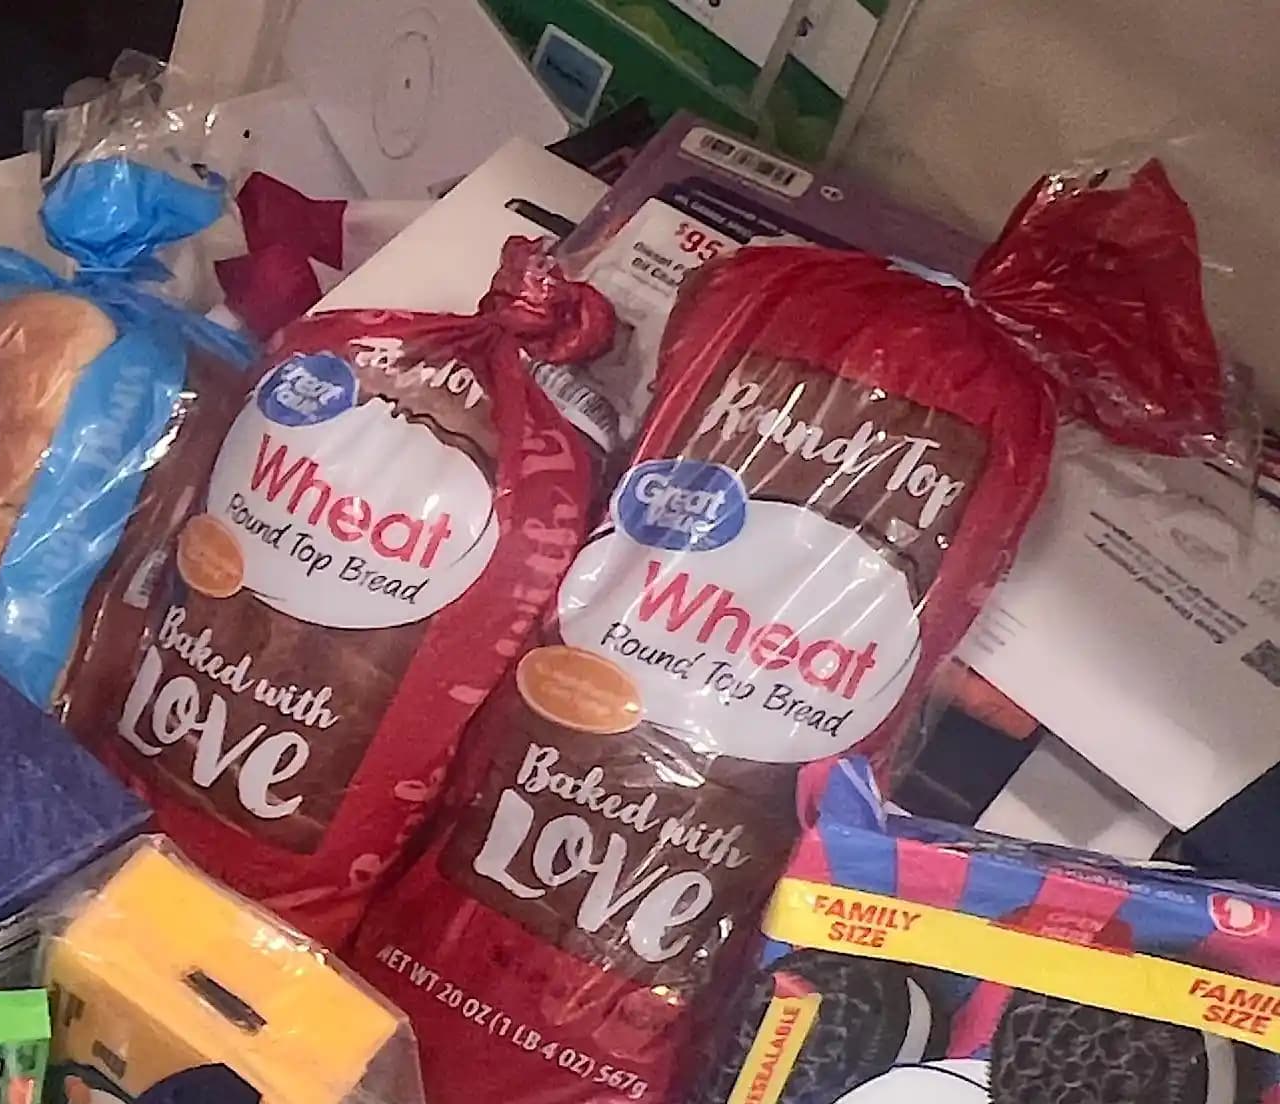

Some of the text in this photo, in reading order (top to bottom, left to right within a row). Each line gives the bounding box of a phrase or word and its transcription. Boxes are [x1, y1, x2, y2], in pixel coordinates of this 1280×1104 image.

[251, 434, 453, 568] Wheat
[883, 434, 966, 530] Top
[226, 493, 430, 604] Round Top Bread
[159, 605, 340, 729] Baked with
[601, 622, 855, 738] Round Top Bread
[638, 560, 878, 701] Wheat
[517, 743, 752, 869] Baked with
[812, 894, 923, 931] FAMILY
[828, 920, 889, 948] SIZE
[375, 946, 649, 1100] NET WT 20 OZ (1 LB 4 OZ) 567g
[1189, 978, 1280, 1019] FAMIL
[1202, 1004, 1273, 1036] SIZE
